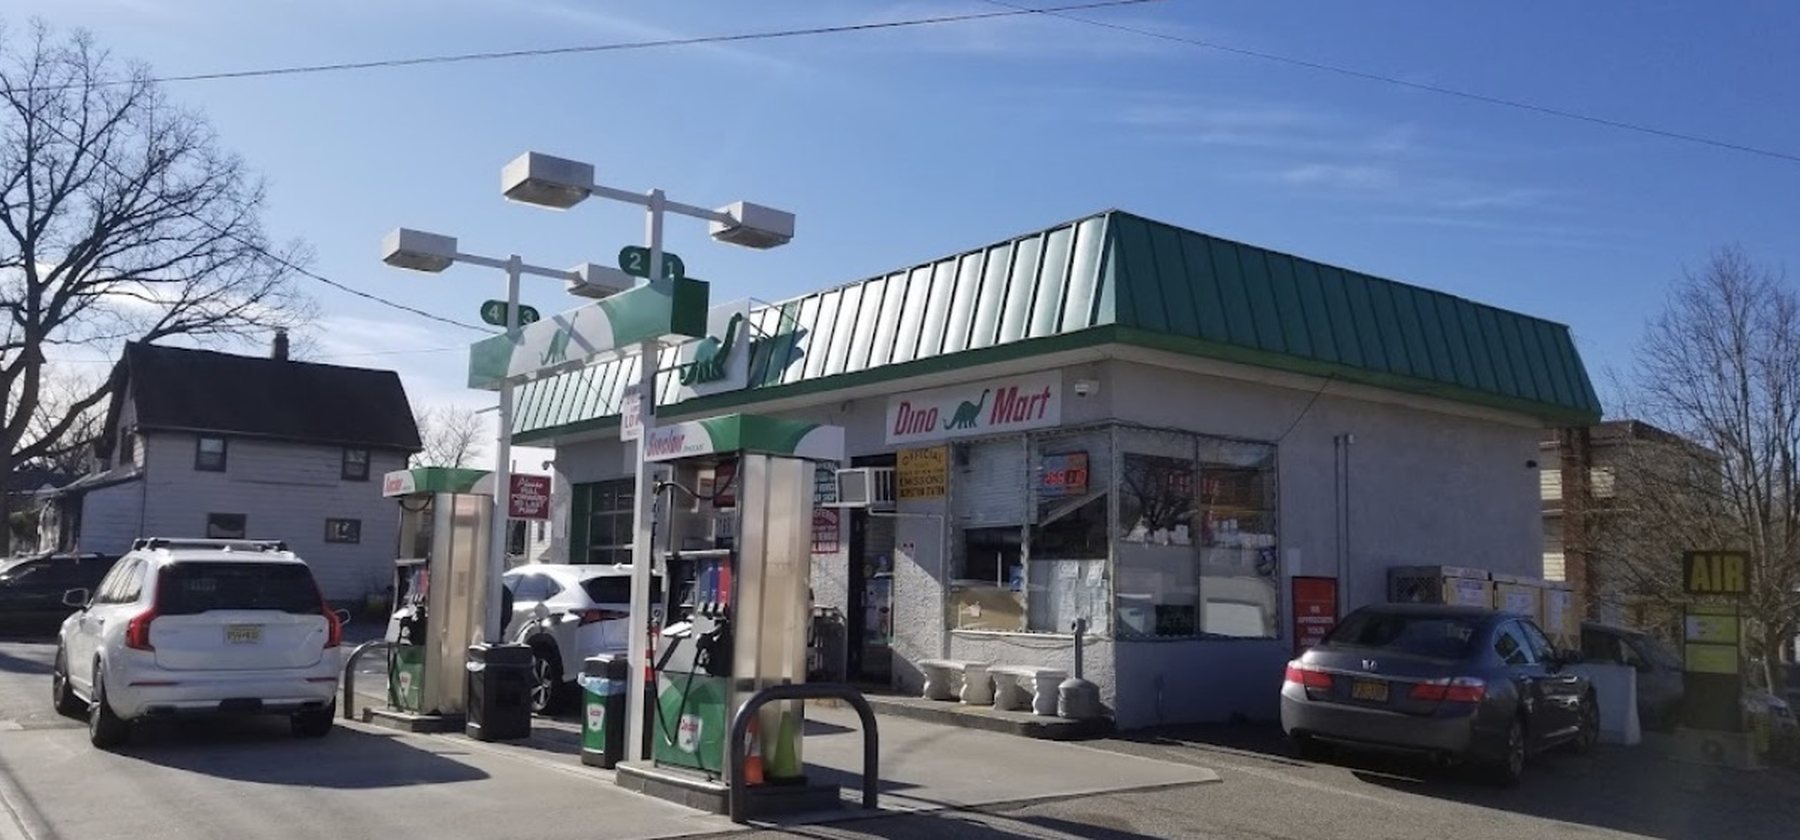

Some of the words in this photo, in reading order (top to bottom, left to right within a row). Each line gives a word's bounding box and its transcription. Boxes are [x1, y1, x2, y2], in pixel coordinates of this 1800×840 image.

[629, 252, 641, 270] 2
[667, 261, 674, 276] 1
[488, 305, 499, 321] 4
[523, 310, 534, 323] 3
[894, 401, 938, 436] Dino
[989, 385, 1051, 426] Mart
[902, 448, 942, 466] OFFICIAL
[1690, 555, 1744, 592] AIR
